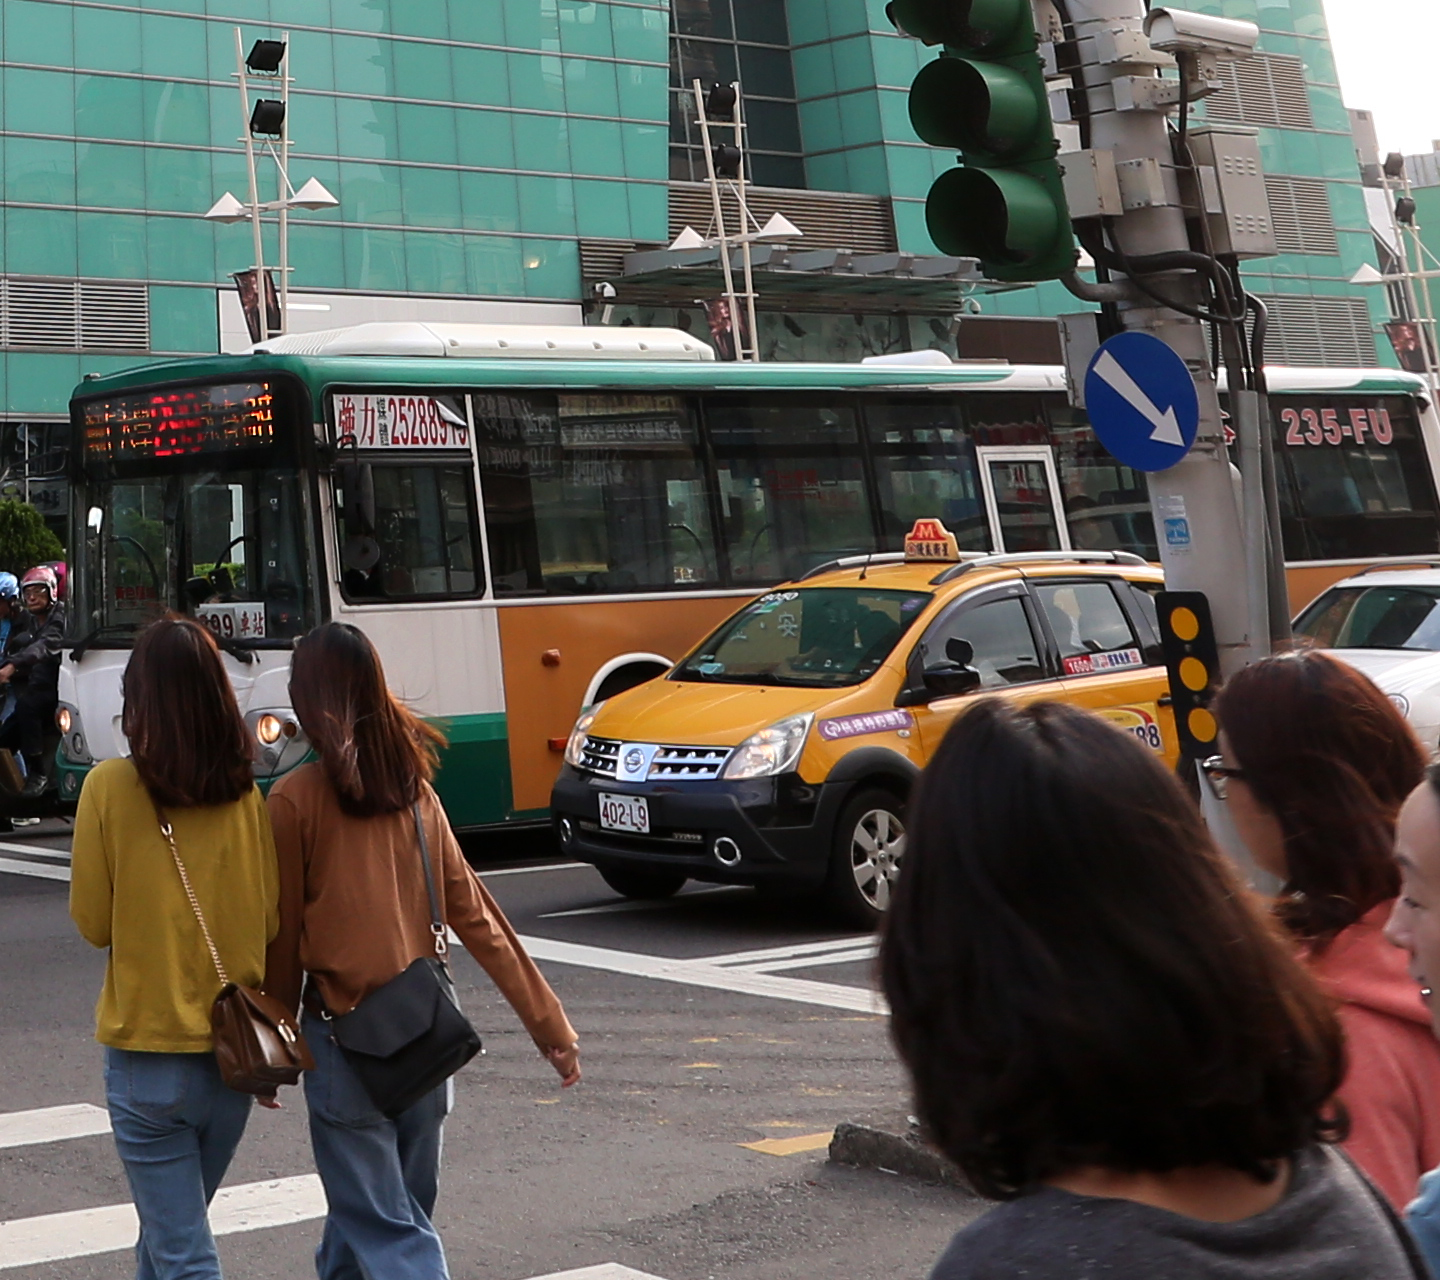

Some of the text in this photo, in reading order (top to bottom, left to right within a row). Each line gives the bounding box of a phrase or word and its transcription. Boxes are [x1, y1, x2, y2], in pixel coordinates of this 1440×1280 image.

[338, 397, 375, 445] 強力
[1280, 407, 1394, 445] 235-FU
[601, 801, 647, 829] 402-L9
